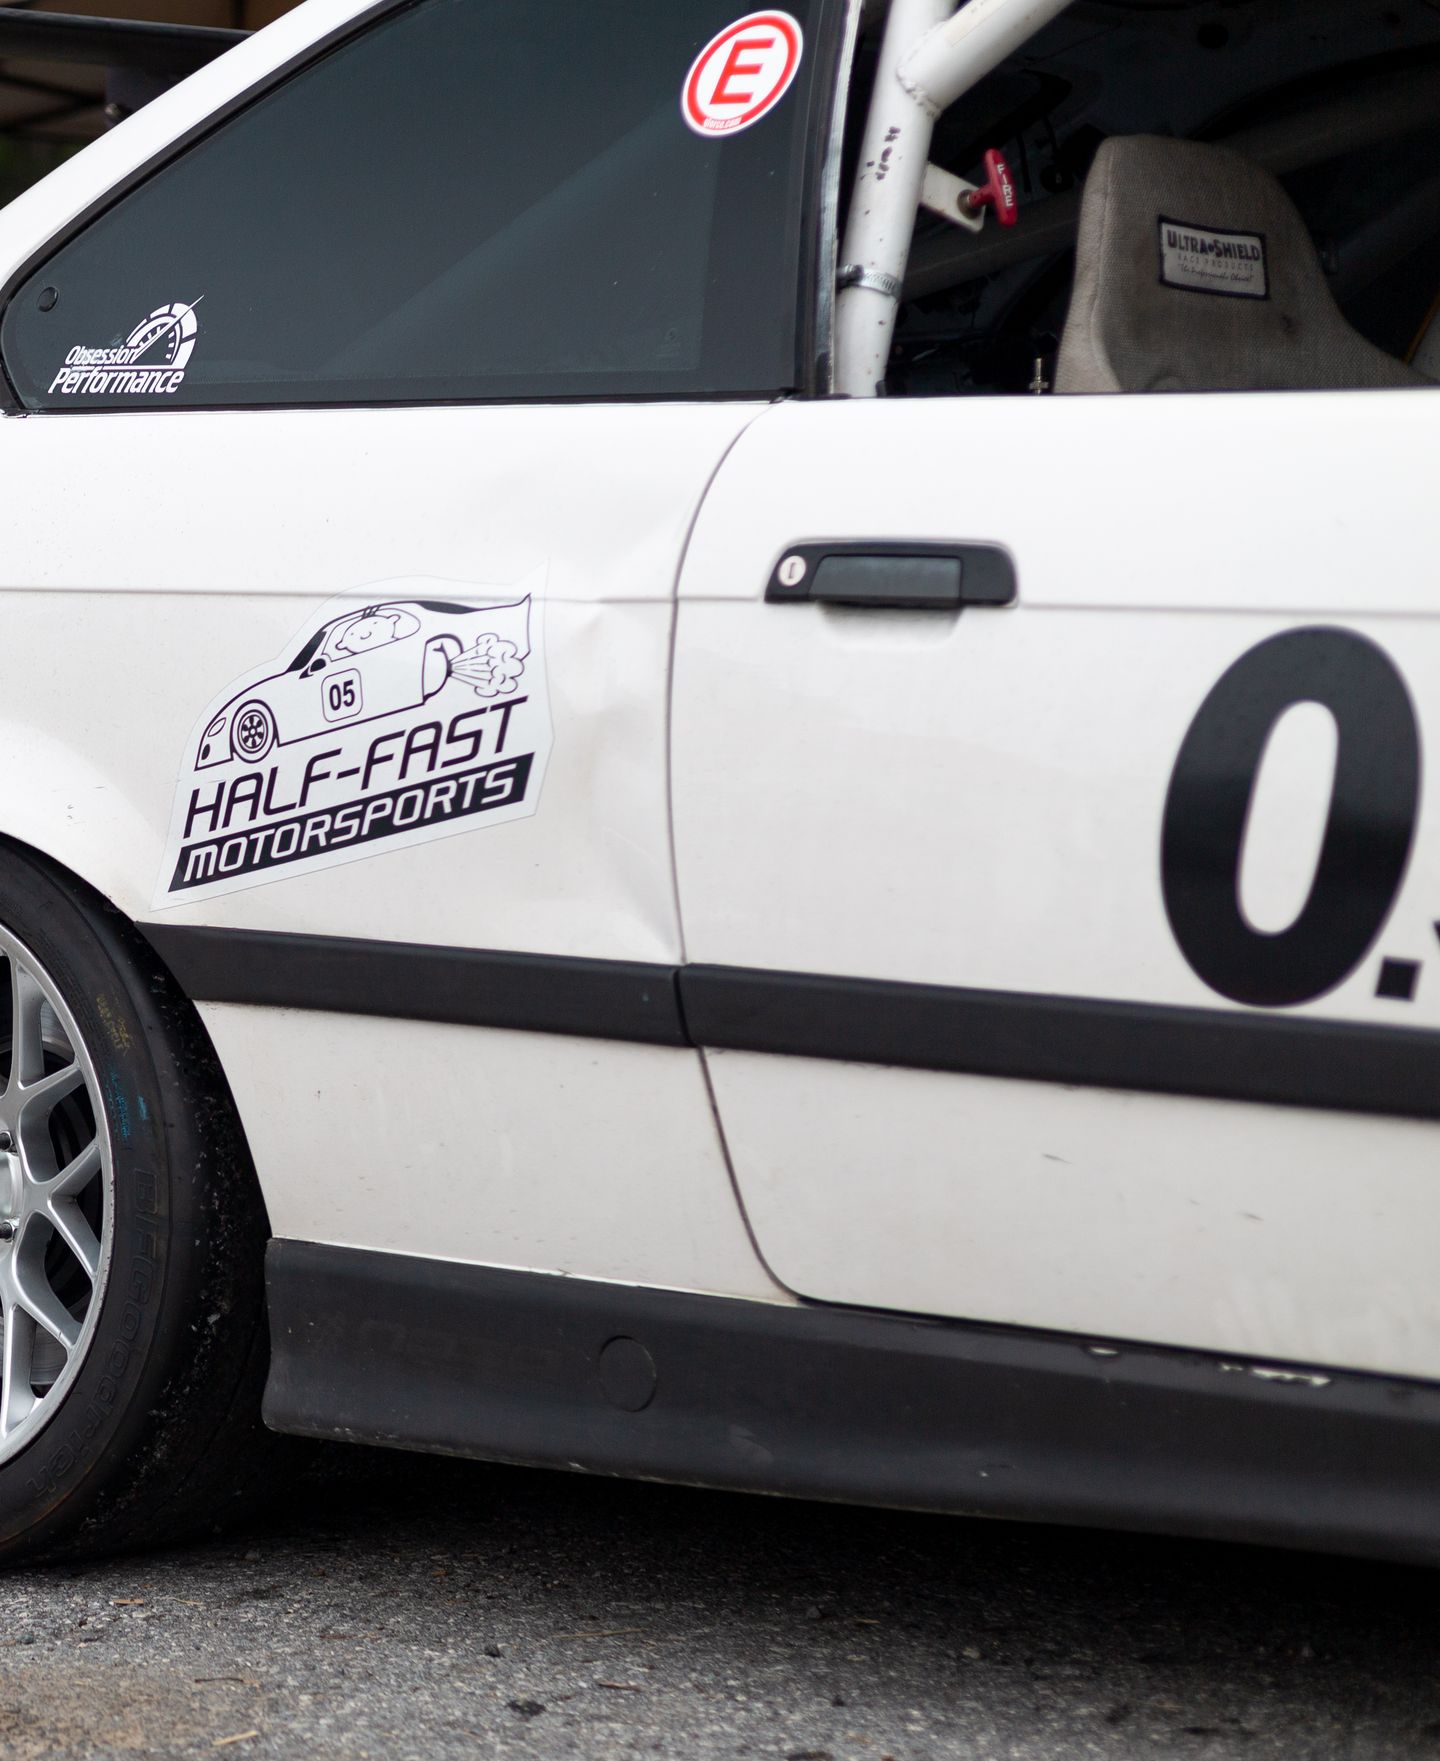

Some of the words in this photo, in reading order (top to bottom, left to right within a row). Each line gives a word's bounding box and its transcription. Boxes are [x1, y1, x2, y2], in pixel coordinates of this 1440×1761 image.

[709, 37, 777, 105] E
[996, 163, 1014, 208] FIRE
[48, 368, 186, 394] Performance
[64, 345, 140, 365] Obsession
[328, 679, 356, 712] 05
[183, 694, 530, 840] HALF-FAST
[183, 762, 518, 883] MOTORSPORTS
[1160, 624, 1440, 1008] 0.
